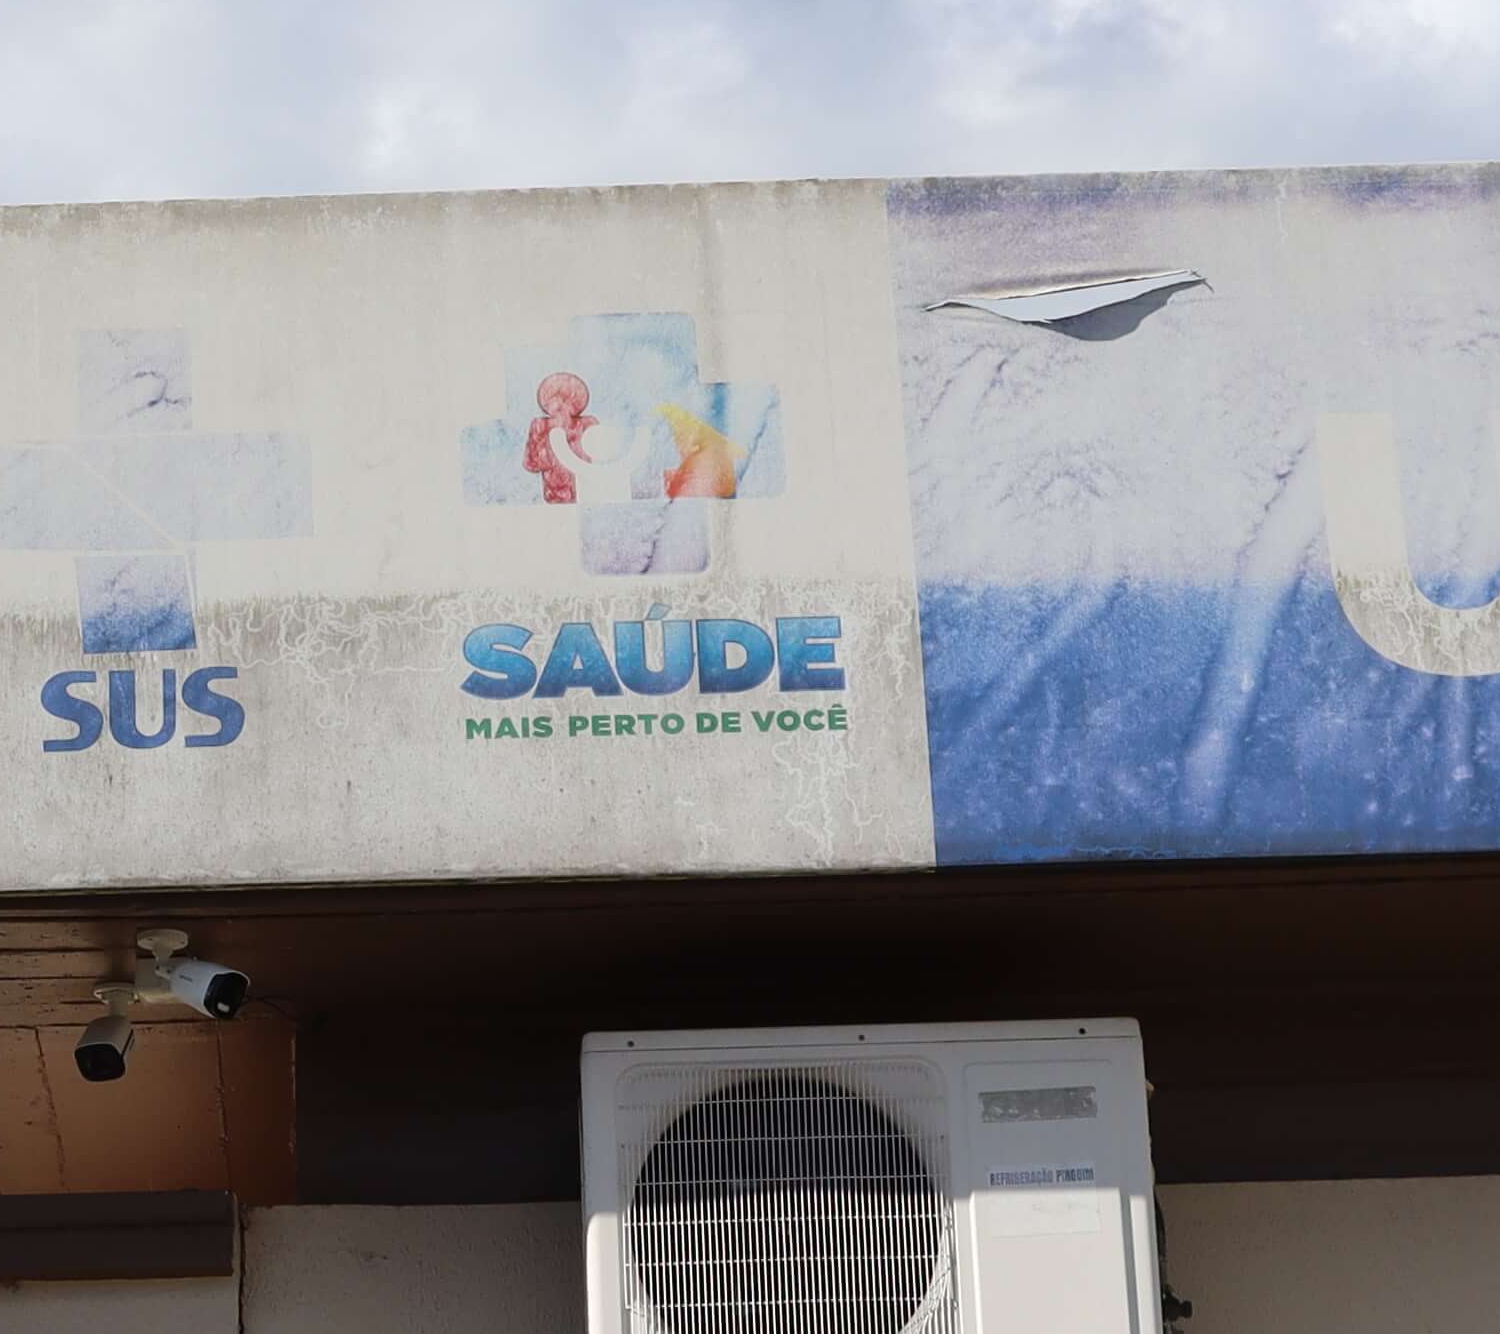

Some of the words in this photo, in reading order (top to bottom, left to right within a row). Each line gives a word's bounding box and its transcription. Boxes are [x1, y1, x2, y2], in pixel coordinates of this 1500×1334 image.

[460, 603, 848, 700] SAÚDE
[40, 666, 245, 754] SUS
[465, 714, 554, 741] MAIS
[569, 710, 686, 738] PERTO
[696, 710, 744, 736] DE
[752, 702, 849, 734] VOCÊ
[989, 1168, 1054, 1187] REFRIGERAÇÃO
